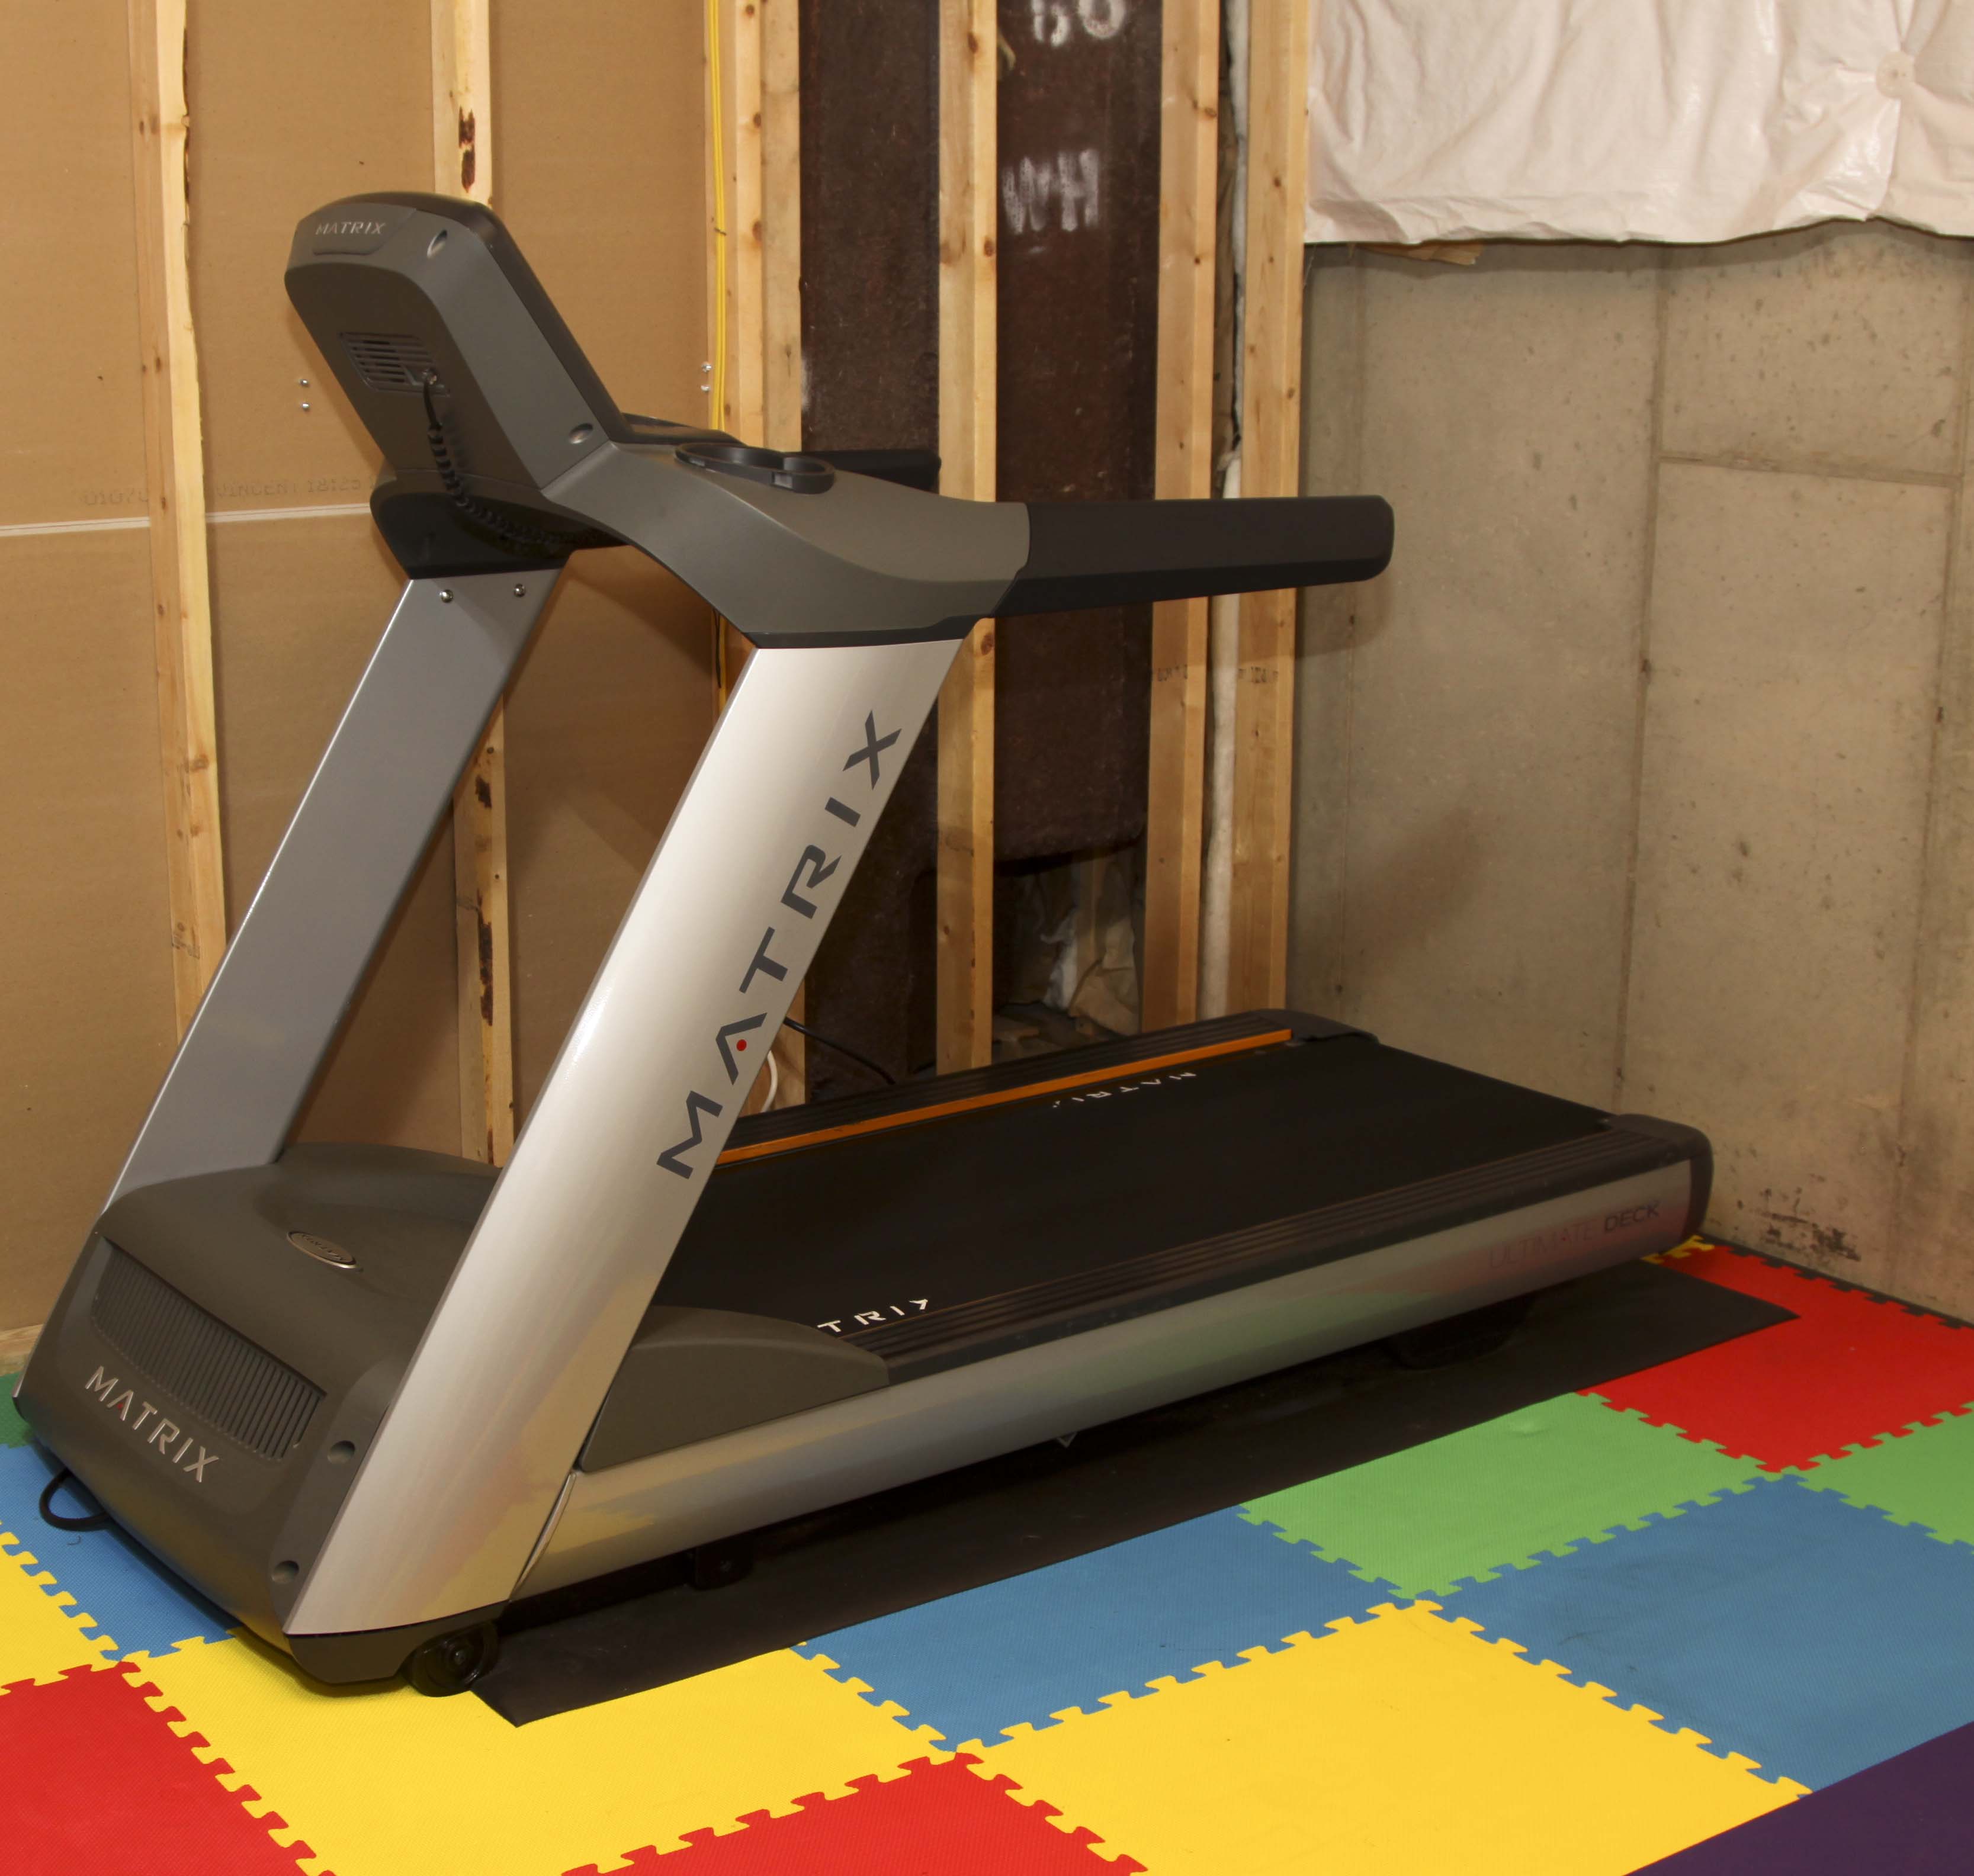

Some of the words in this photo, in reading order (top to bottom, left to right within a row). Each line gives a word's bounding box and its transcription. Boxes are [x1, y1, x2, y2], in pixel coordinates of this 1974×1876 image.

[315, 221, 386, 235] MATRIX
[656, 710, 902, 1180] MATRIX
[1604, 1202, 1660, 1233] DECK
[85, 1365, 220, 1483] MATRIX
